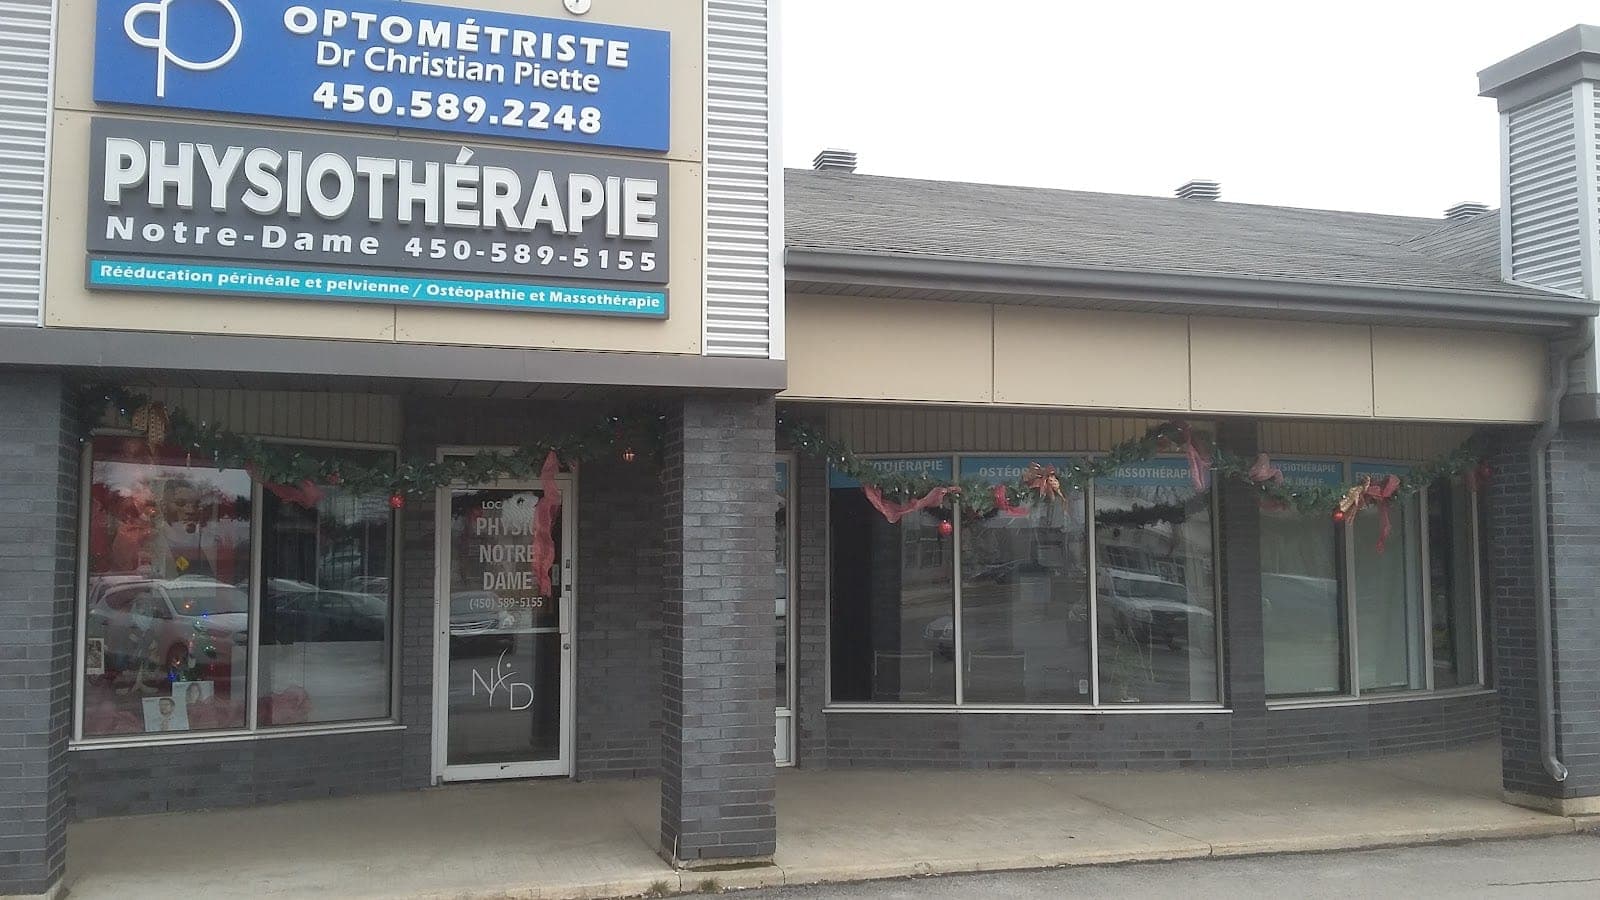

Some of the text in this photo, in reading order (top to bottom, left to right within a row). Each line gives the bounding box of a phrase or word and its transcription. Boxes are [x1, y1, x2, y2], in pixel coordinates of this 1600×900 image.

[283, 5, 630, 68] OPTOMÉTRISTE
[316, 40, 600, 93] Dr Christian Piette
[312, 81, 602, 134] 450.589.2248
[103, 136, 659, 241] PHYSIOTHÉRAPIE
[105, 215, 657, 272] Notre-Dame 450-589-5155
[100, 264, 213, 283] Rééducation
[217, 271, 301, 289] périnéale
[304, 277, 323, 289] et
[326, 279, 410, 295] pelvienne
[426, 283, 525, 303] Ostéopathie
[529, 290, 546, 302] et
[549, 291, 661, 310] Massothérapie
[480, 544, 536, 563] NOTRE
[469, 597, 543, 610] (450) 589-5155
[483, 571, 533, 591] DAME
